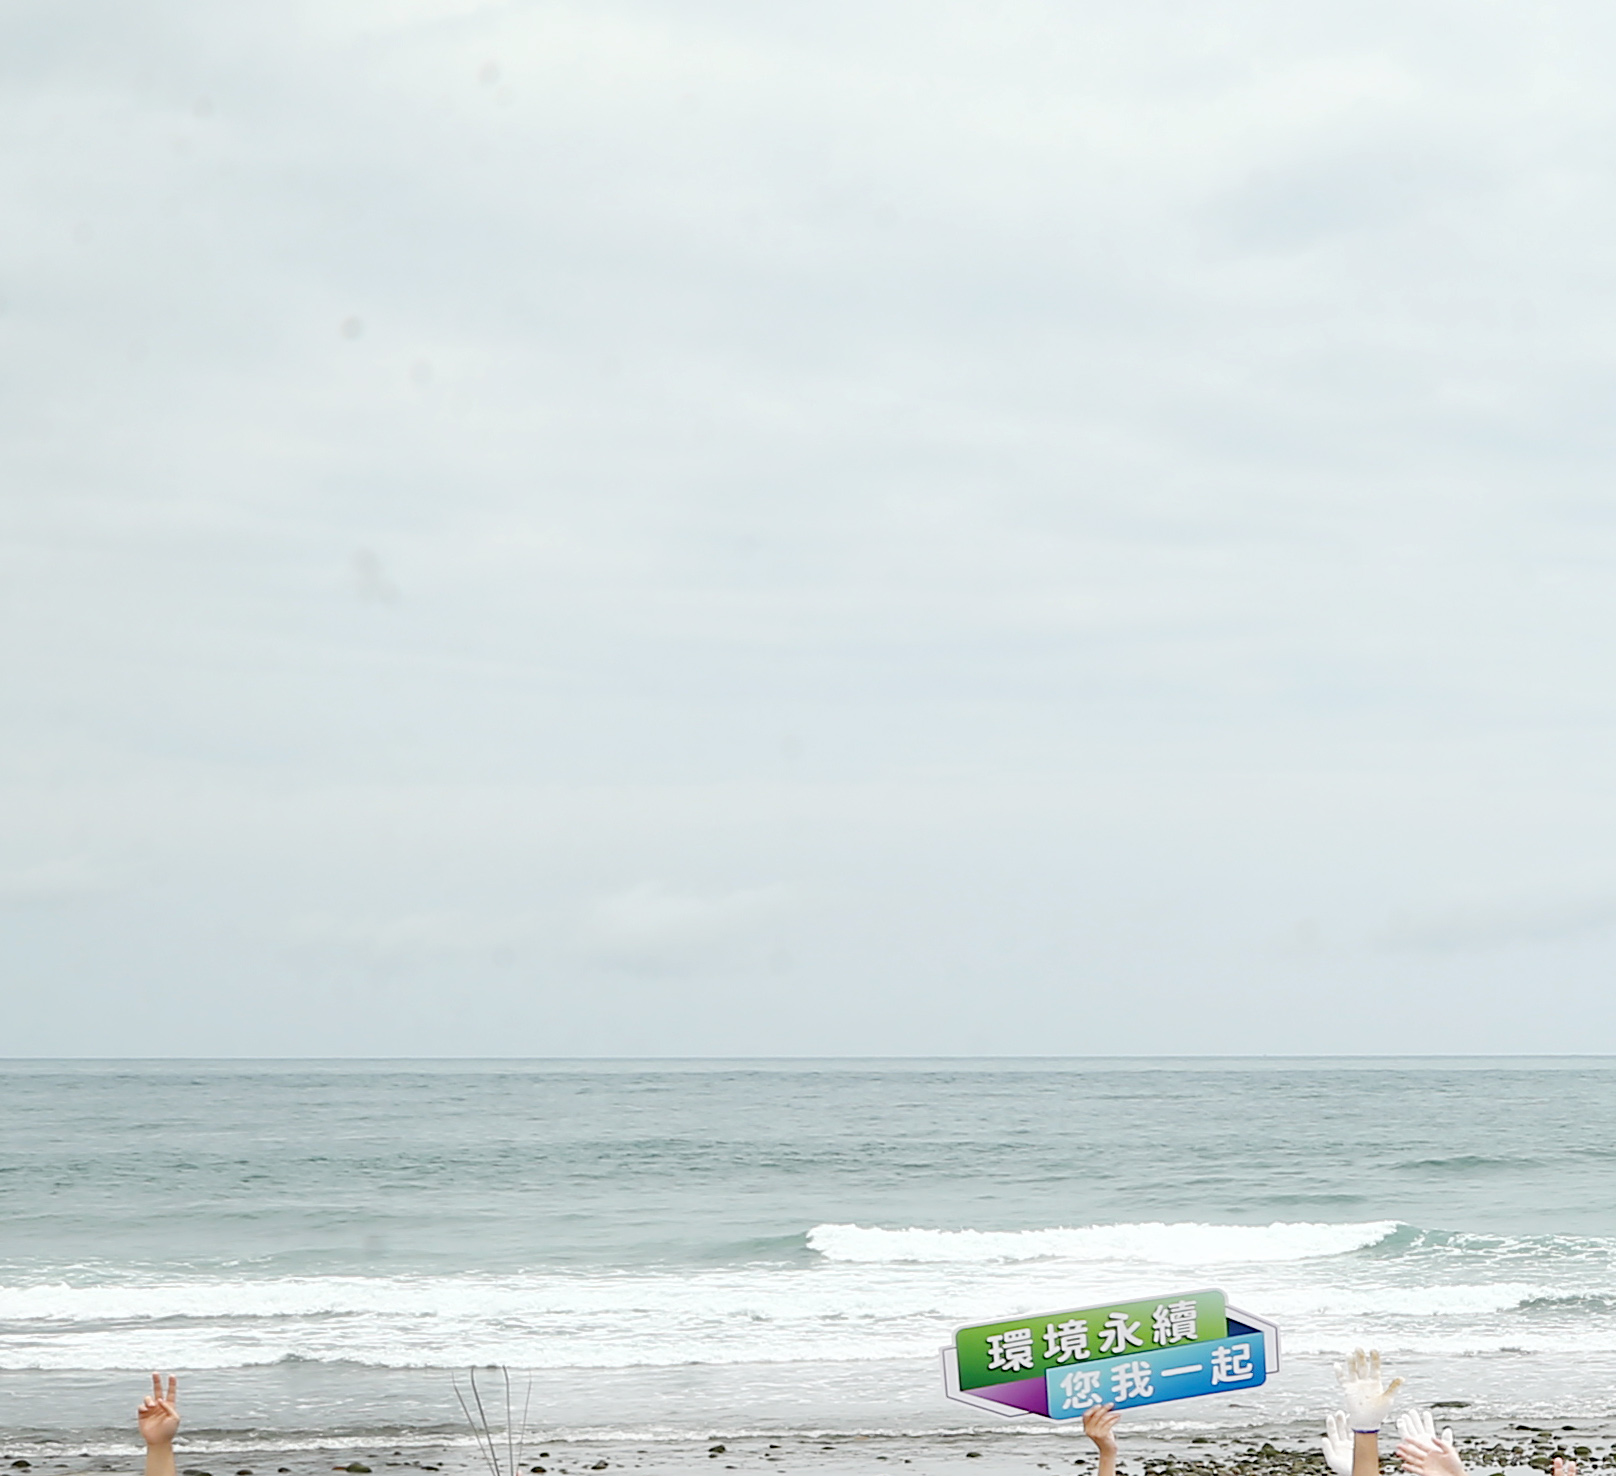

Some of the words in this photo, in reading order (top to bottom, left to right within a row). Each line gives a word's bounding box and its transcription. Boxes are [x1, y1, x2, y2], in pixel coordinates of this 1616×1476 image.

[986, 1300, 1198, 1372] 環境永續
[1059, 1340, 1254, 1411] 您我一起
